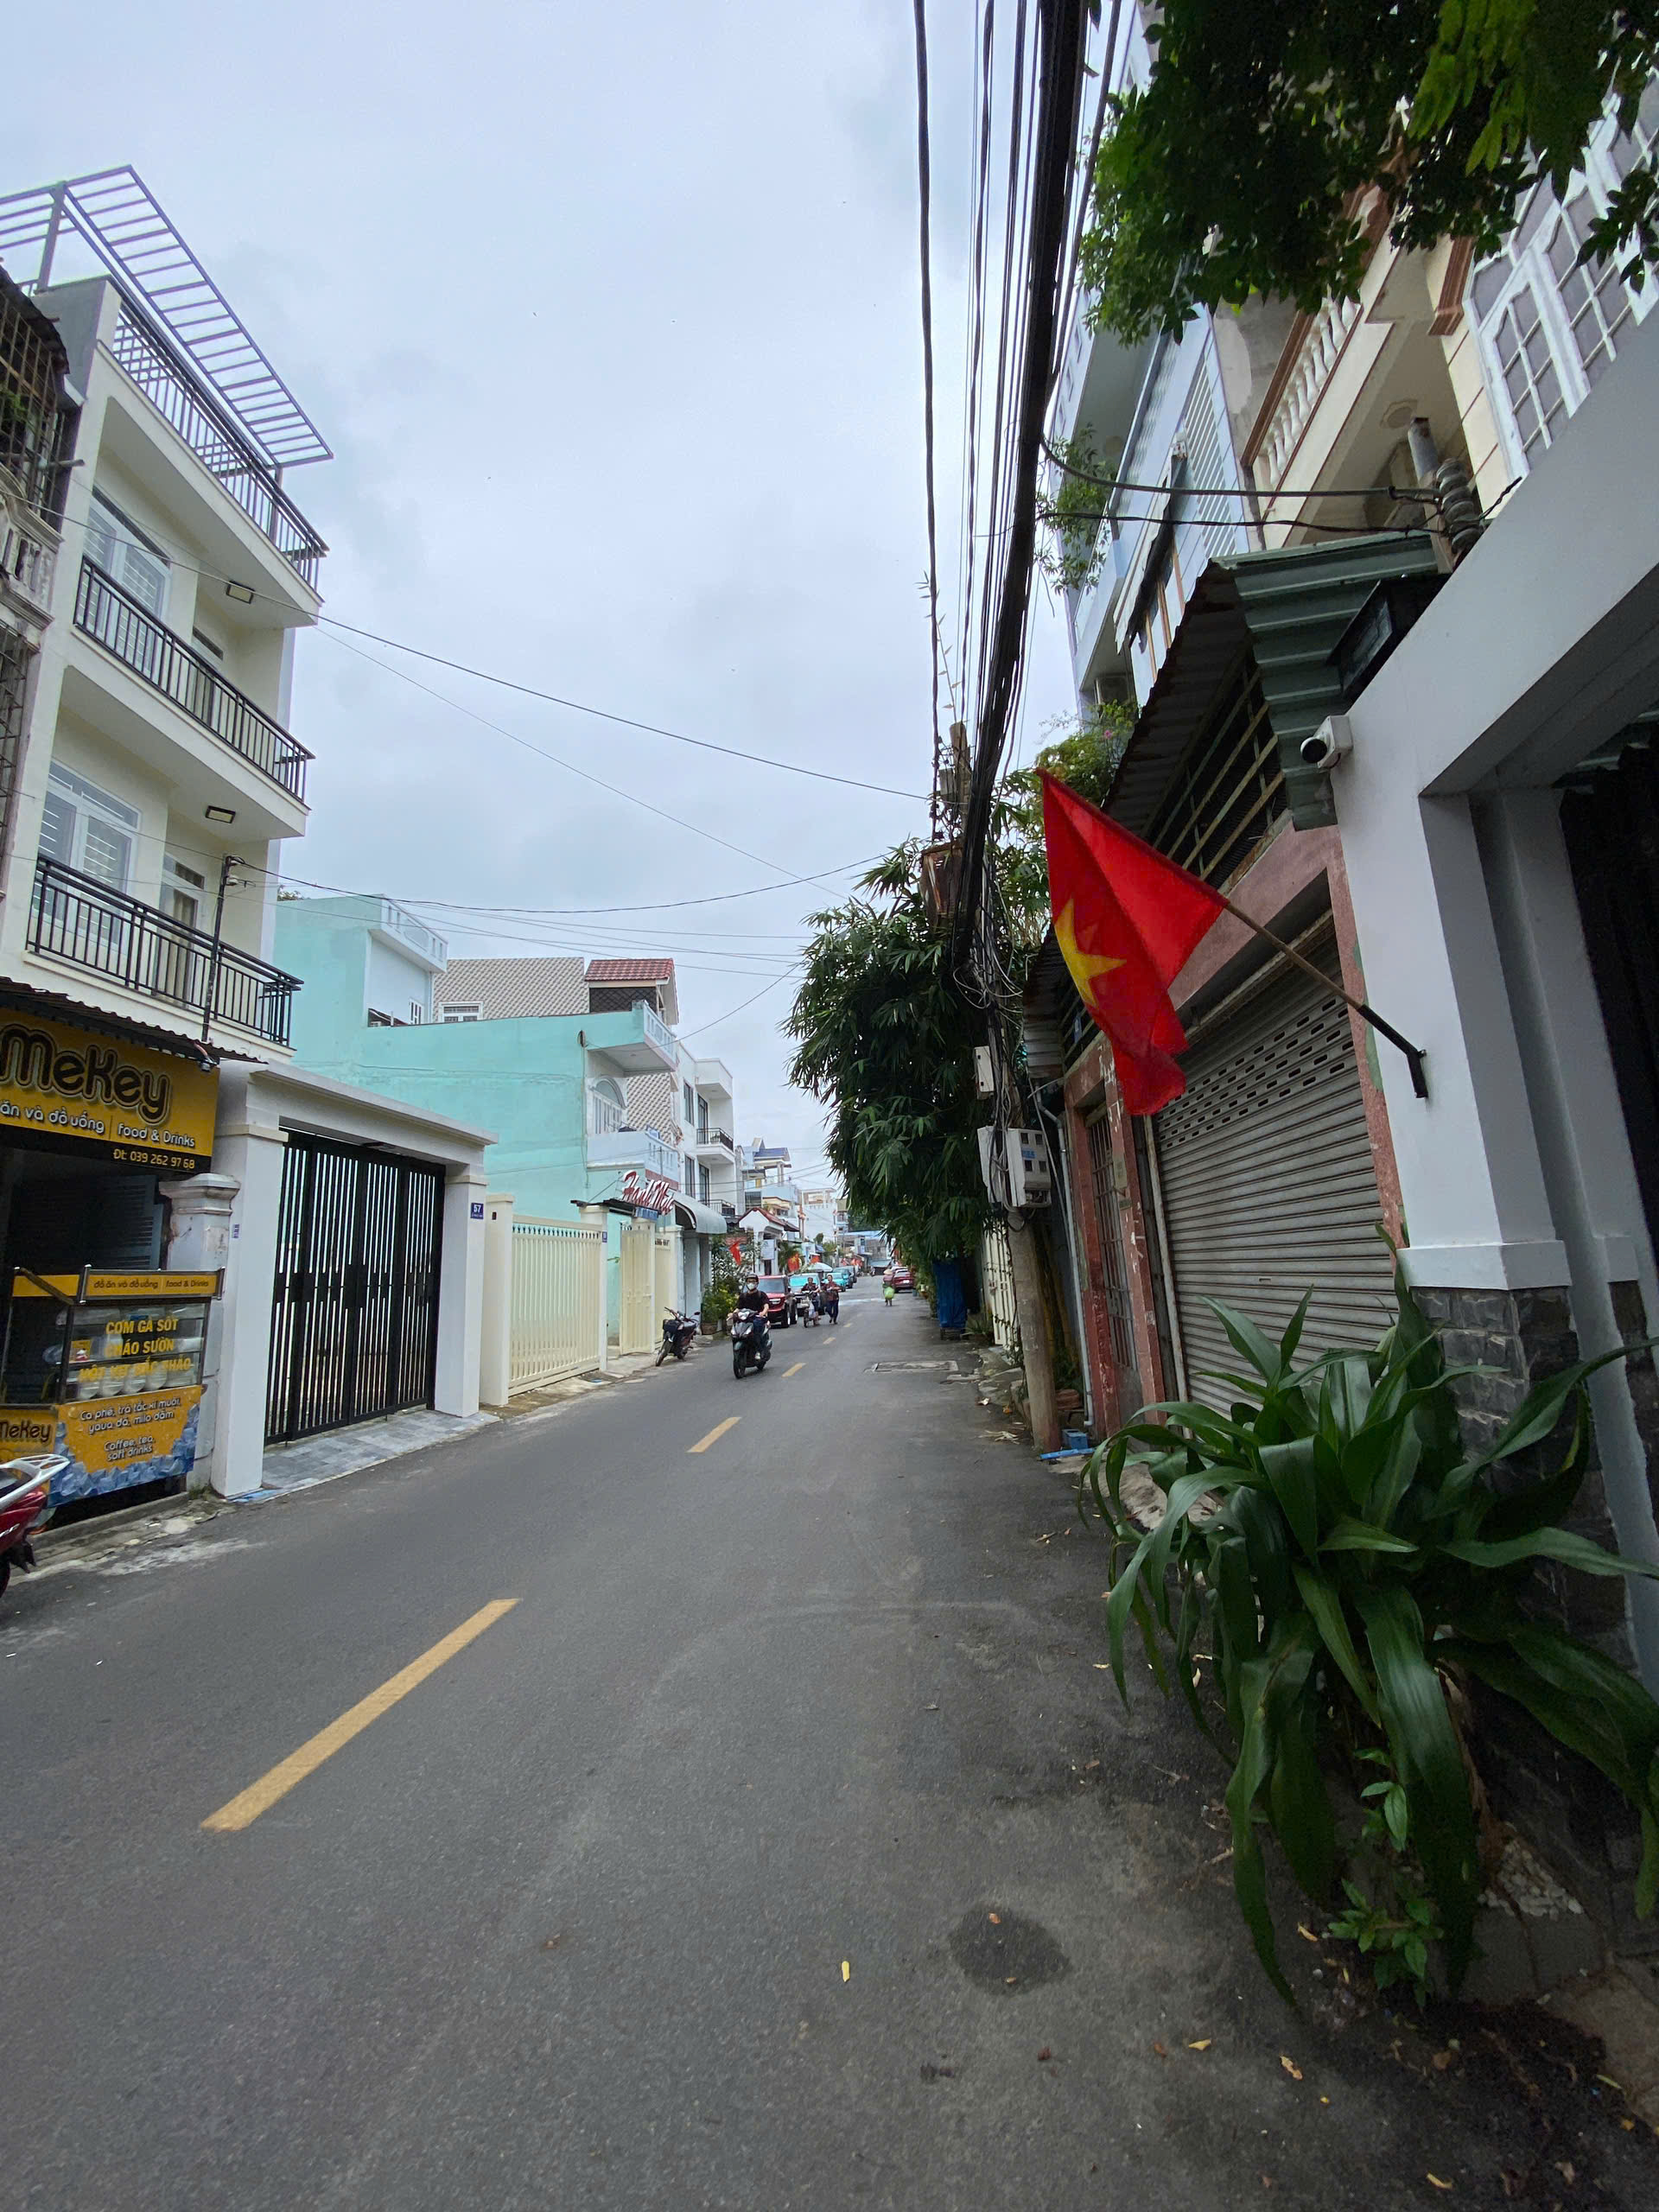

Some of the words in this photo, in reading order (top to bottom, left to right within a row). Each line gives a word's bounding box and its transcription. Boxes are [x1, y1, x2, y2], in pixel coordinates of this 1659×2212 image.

[0, 1099, 20, 1116] ăn
[25, 1105, 44, 1121] và
[48, 1107, 68, 1124] đồ
[70, 1110, 105, 1134] uống
[150, 1128, 160, 1141] &
[162, 1130, 195, 1147] Drinks
[130, 1150, 149, 1163] 039
[150, 1154, 168, 1166] 262
[170, 1156, 181, 1167] 97
[182, 1158, 195, 1169] 68
[473, 1204, 482, 1213] 57
[107, 1450, 125, 1461] soft
[127, 1445, 153, 1457] drinks
